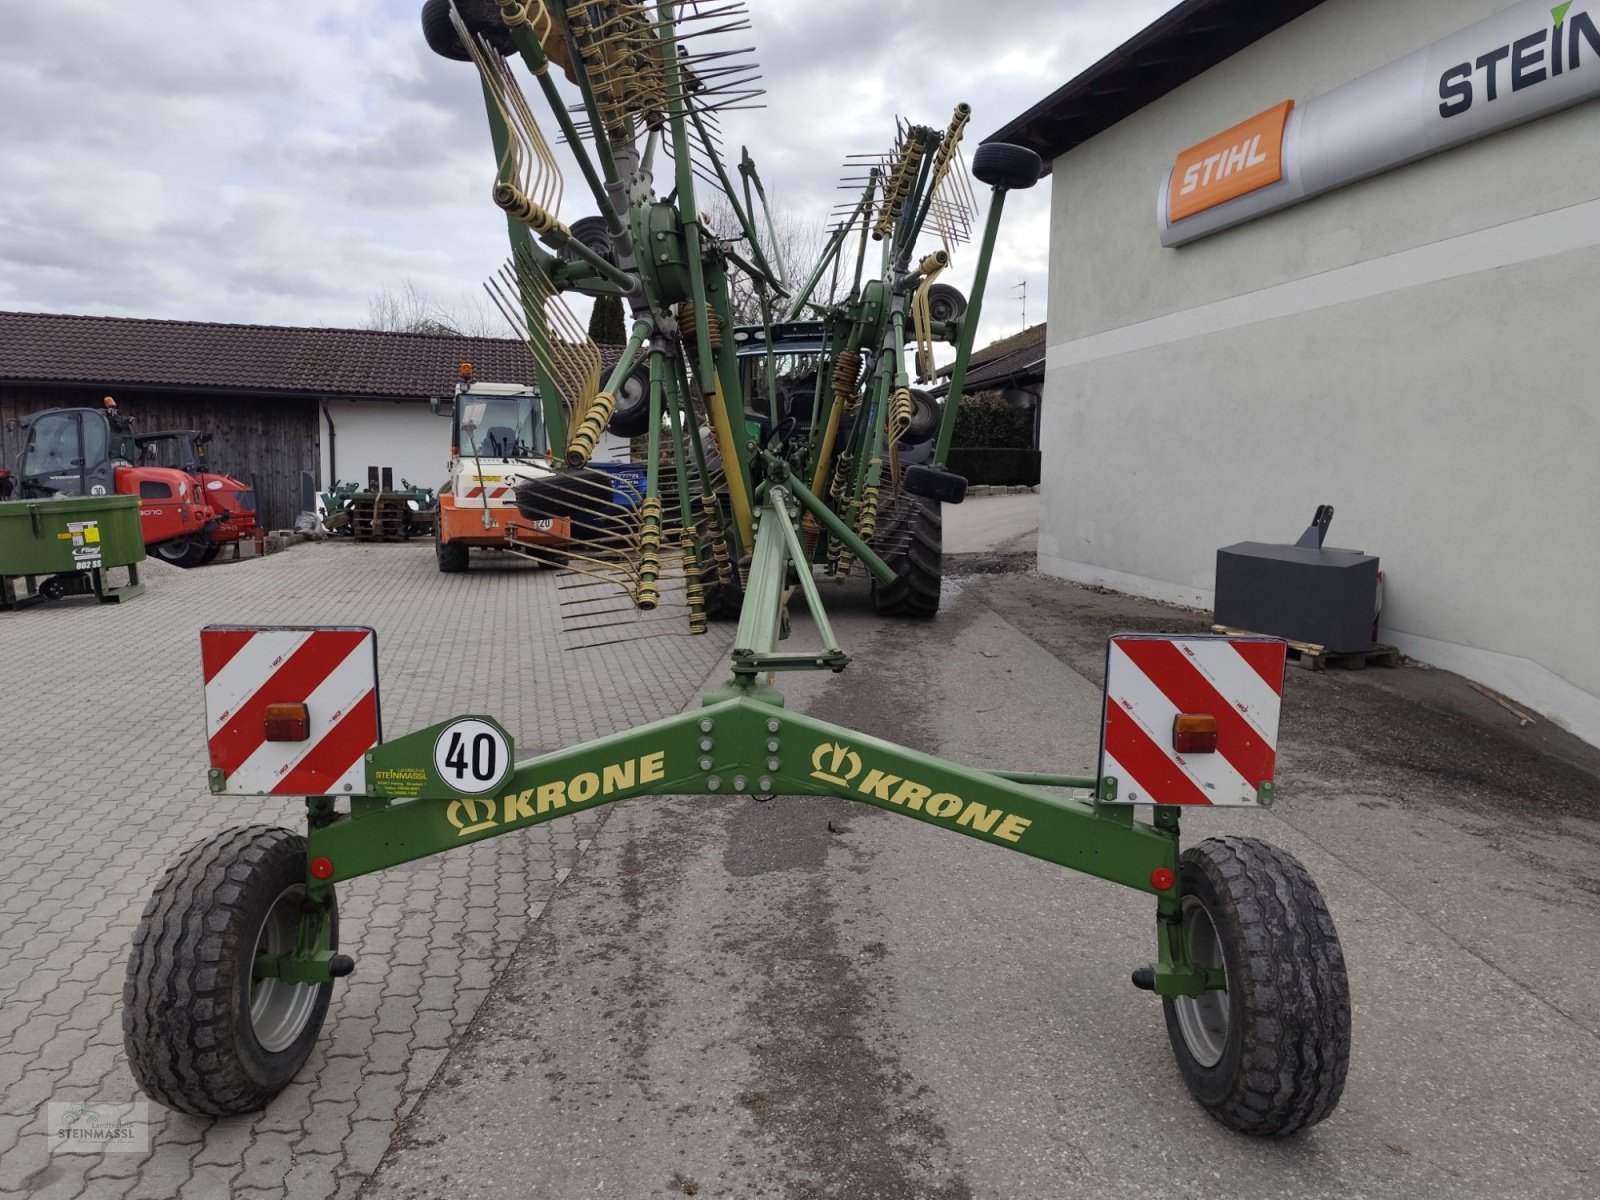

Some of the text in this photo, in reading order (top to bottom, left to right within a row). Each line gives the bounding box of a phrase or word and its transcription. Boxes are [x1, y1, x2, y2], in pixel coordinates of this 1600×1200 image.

[1180, 134, 1267, 197] STIHL
[539, 519, 551, 528] 20
[375, 769, 428, 780] STEINMASSL
[445, 732, 496, 781] 40
[503, 750, 665, 824] KRONE
[858, 768, 1033, 843] KRONE
